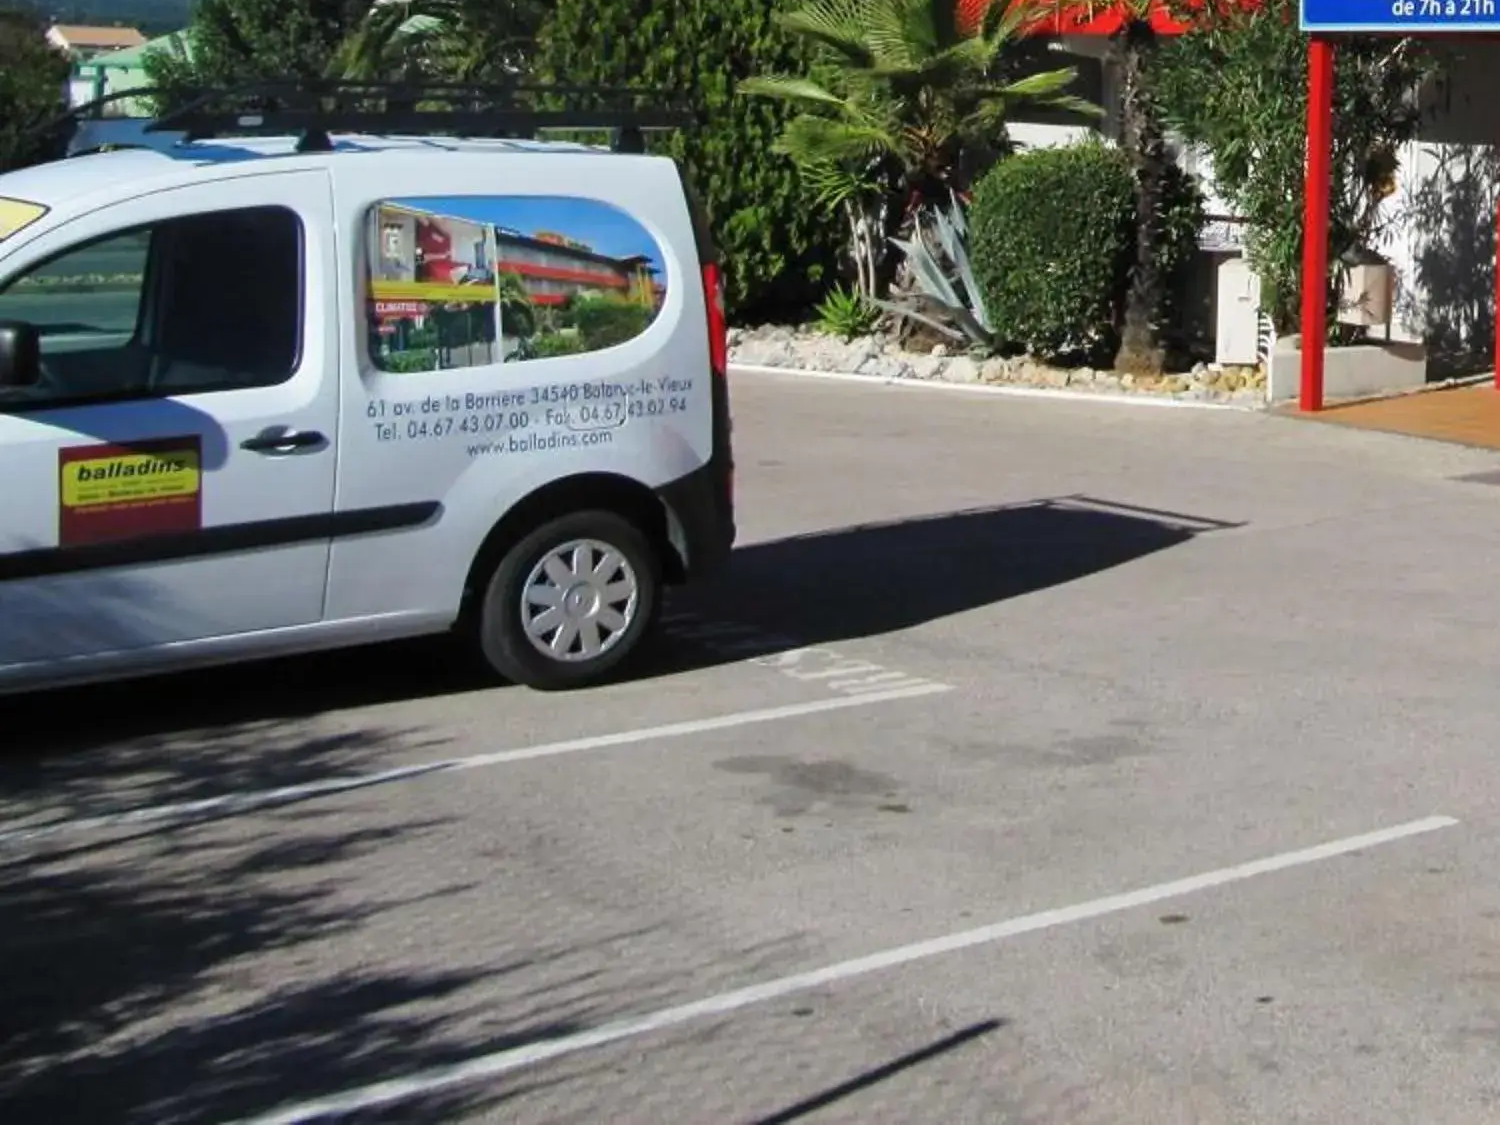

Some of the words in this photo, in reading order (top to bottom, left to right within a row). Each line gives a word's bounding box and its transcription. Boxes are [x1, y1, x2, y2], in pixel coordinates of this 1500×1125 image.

[421, 394, 441, 414] de
[445, 393, 465, 412] la
[77, 457, 186, 482] balladins
